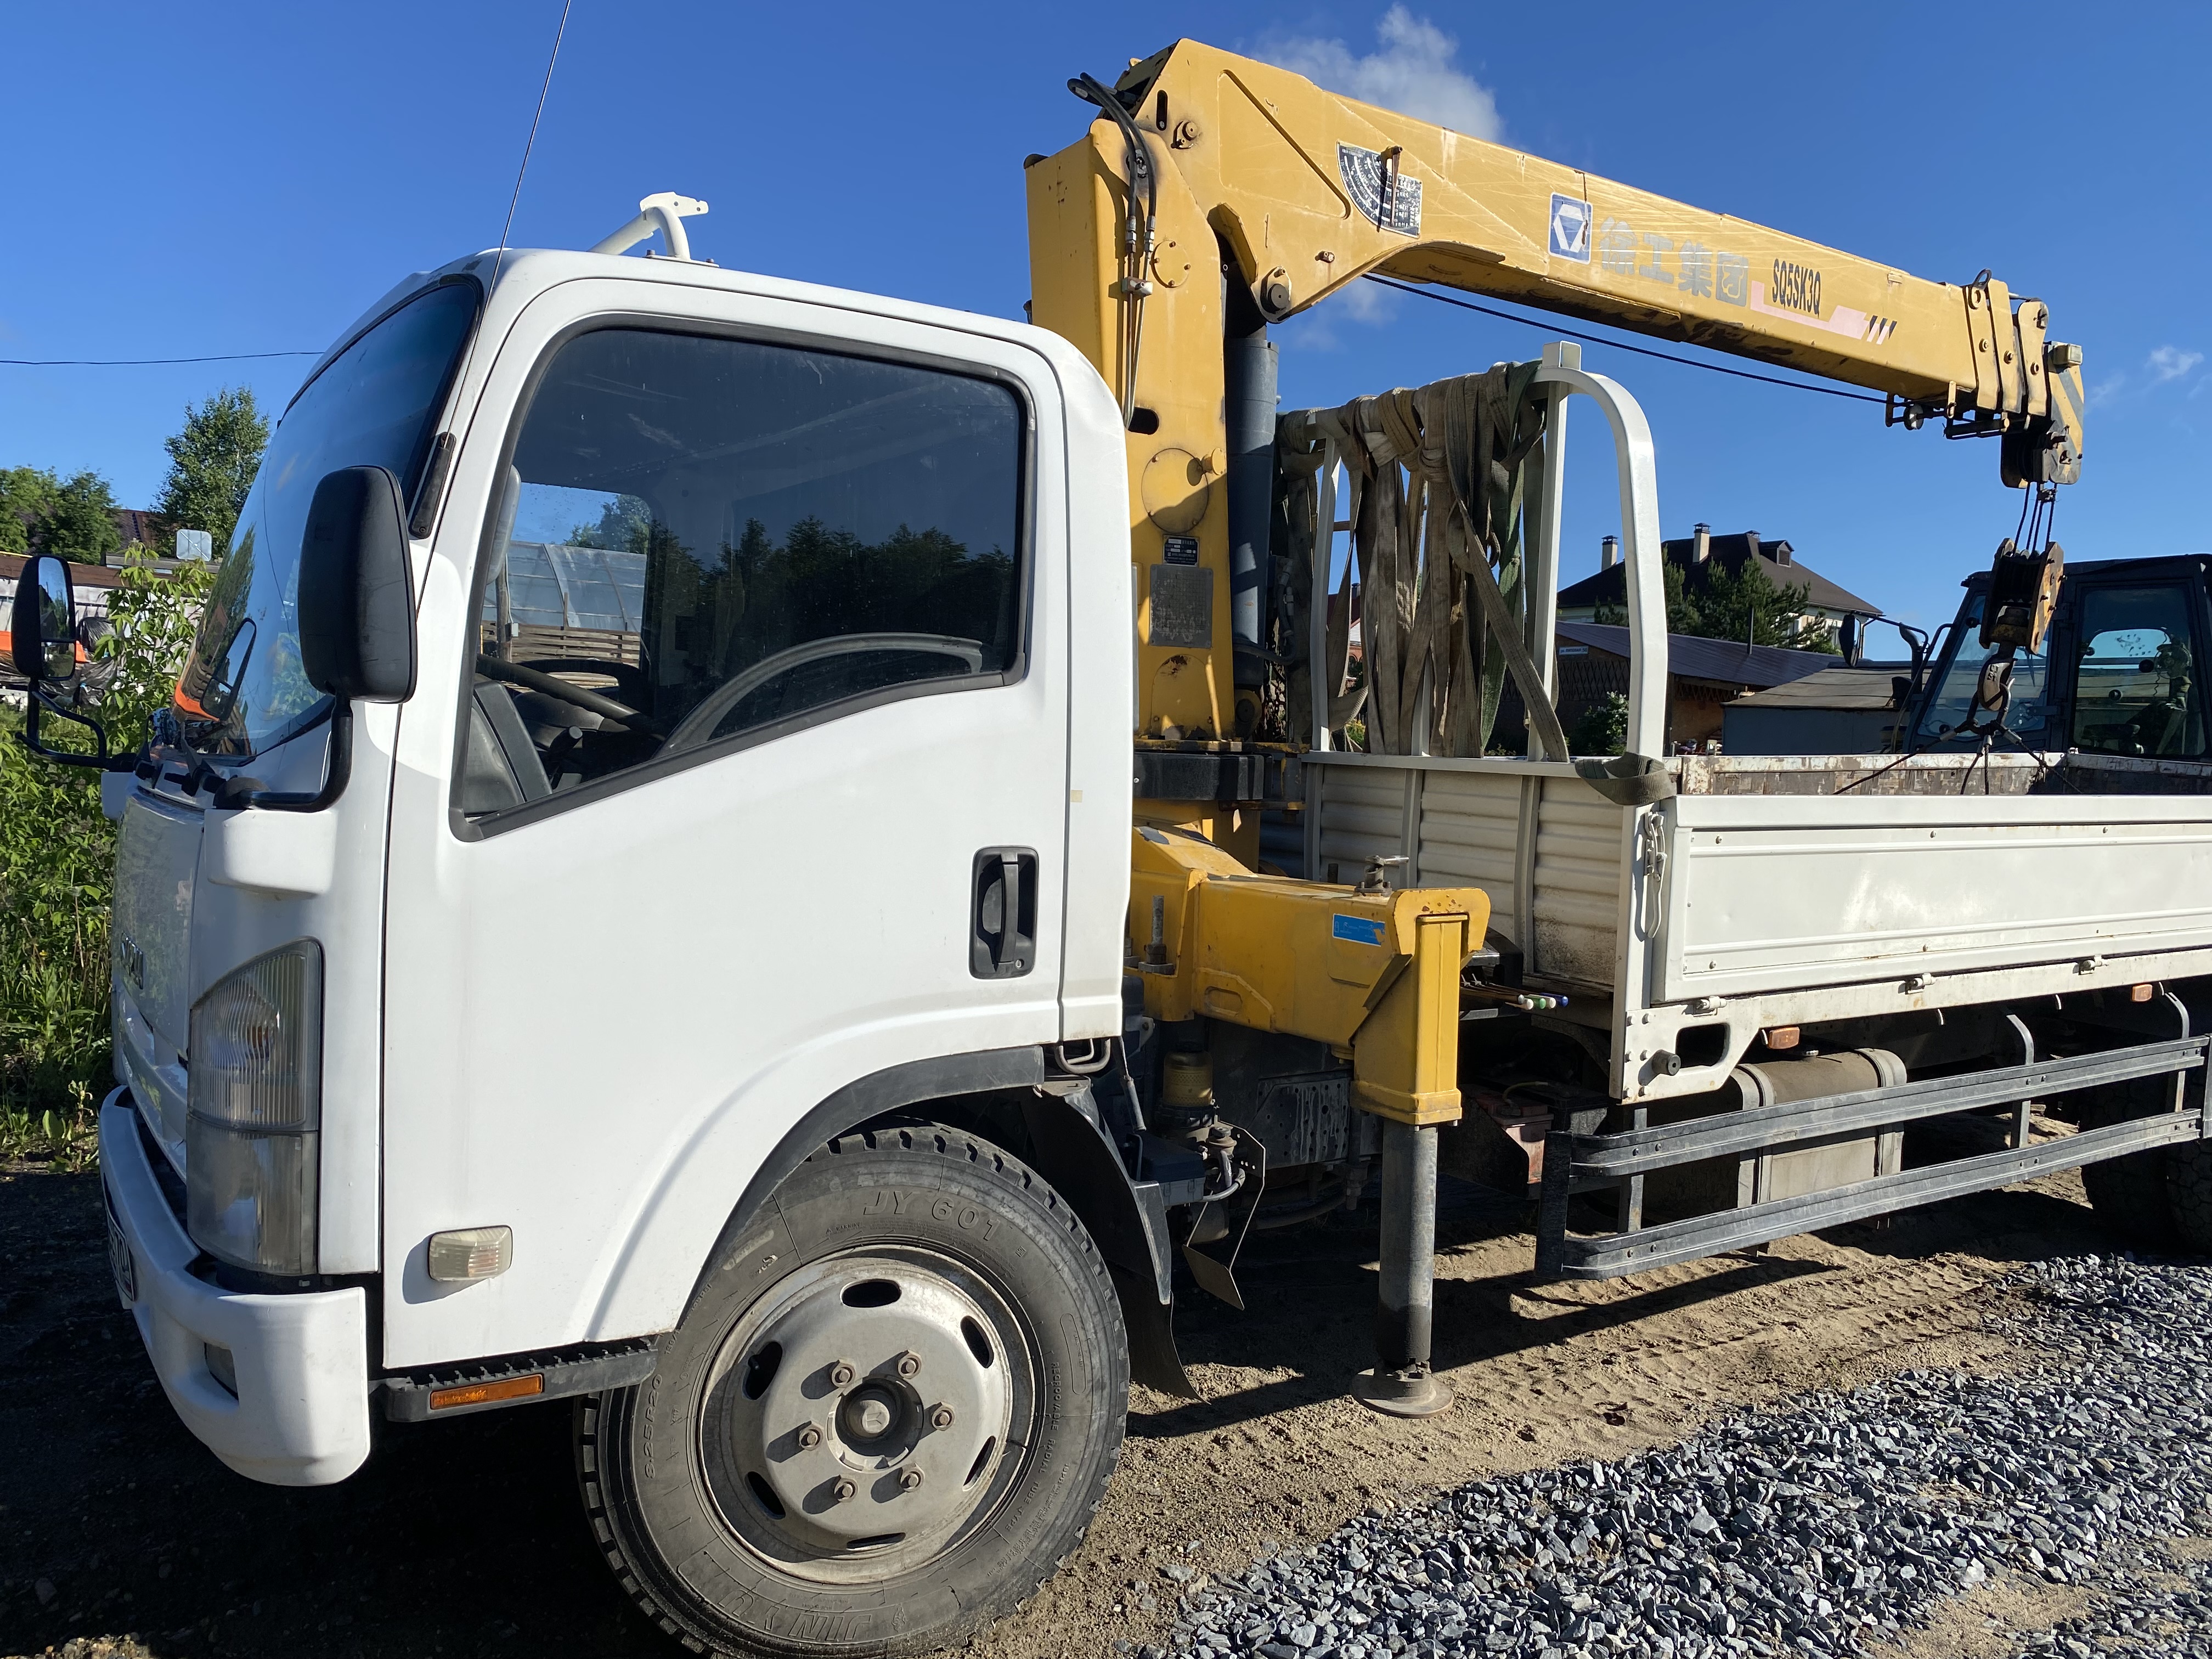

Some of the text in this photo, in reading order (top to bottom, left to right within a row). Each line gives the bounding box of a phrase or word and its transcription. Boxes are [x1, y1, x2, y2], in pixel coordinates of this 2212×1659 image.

[1772, 258, 1821, 319] SQ5SK3Q
[863, 1190, 922, 1215] JY
[932, 1197, 1002, 1242] 601
[644, 1374, 663, 1479] 8.25R20
[1039, 1438, 1056, 1474] RADIAL
[1024, 1481, 1041, 1504] TUBE
[1005, 1506, 1025, 1532] TYPE
